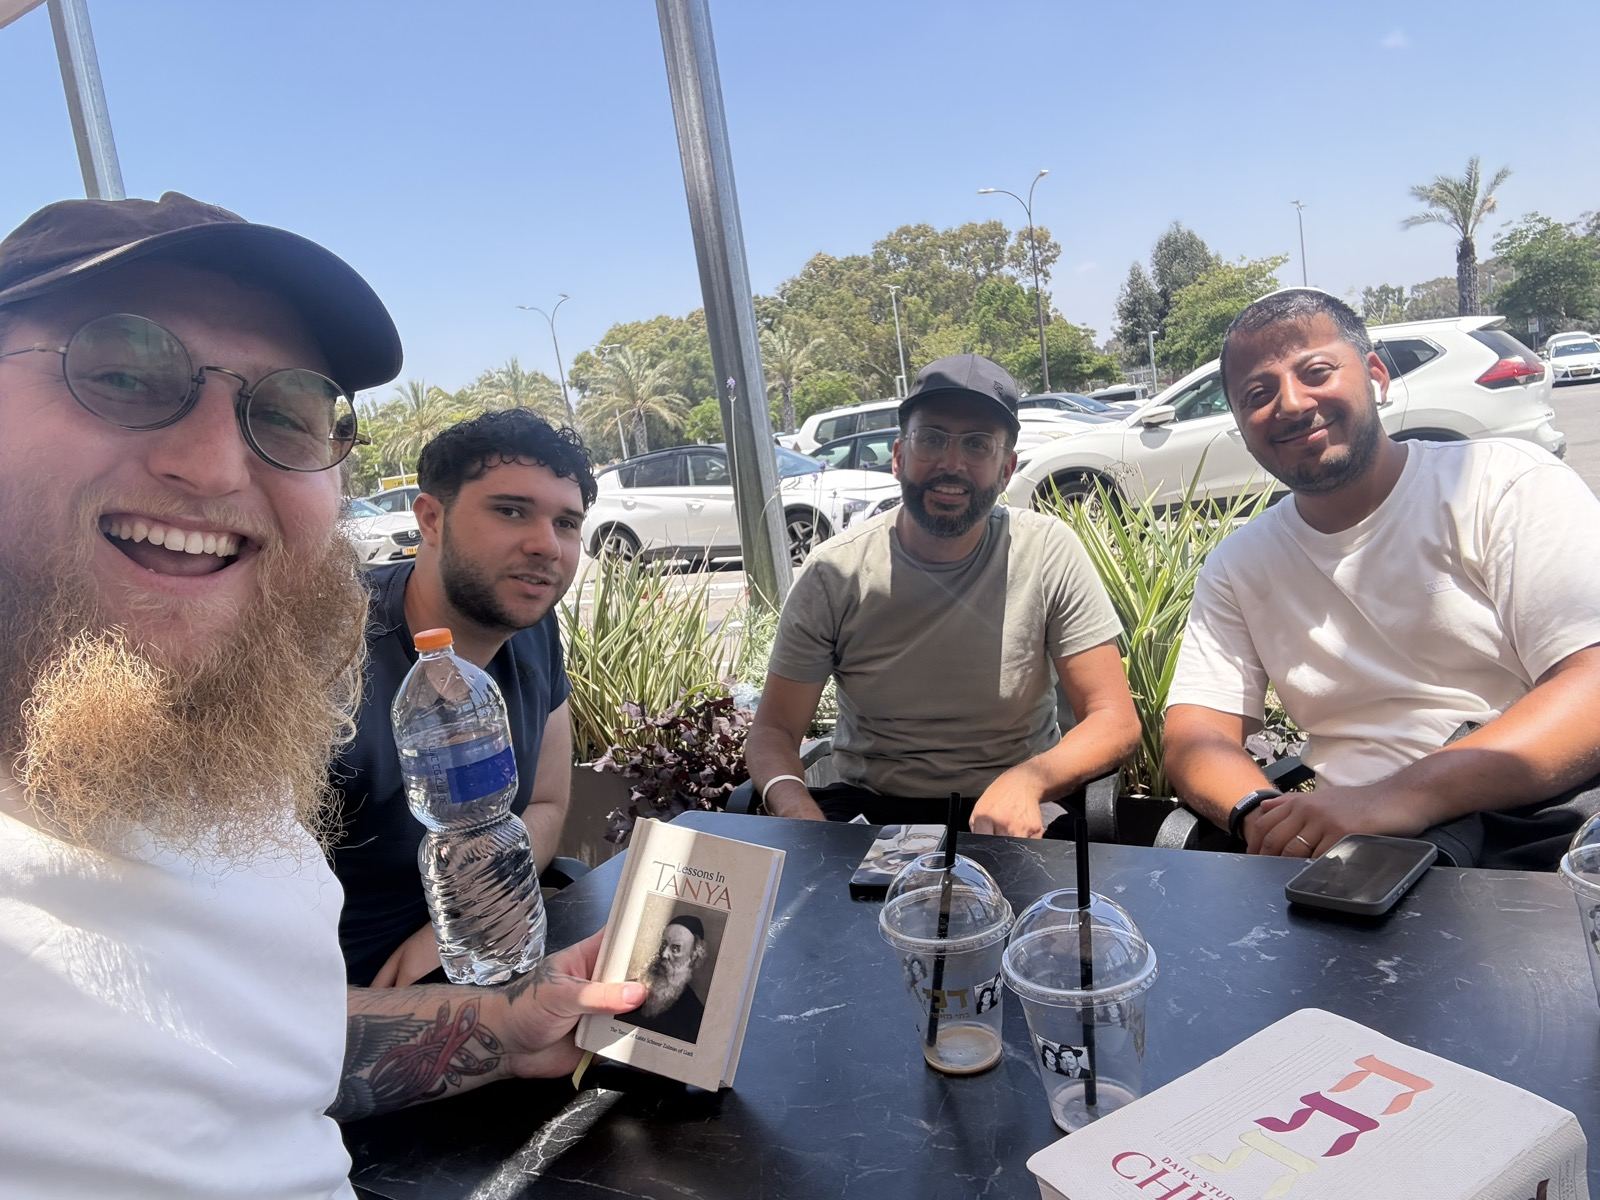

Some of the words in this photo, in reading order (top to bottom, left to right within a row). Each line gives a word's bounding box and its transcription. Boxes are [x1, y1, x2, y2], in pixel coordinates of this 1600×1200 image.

[652, 860, 732, 910] TANYA
[676, 862, 714, 881] Lessons
[715, 871, 726, 884] In
[1161, 1157, 1200, 1181] DAILY
